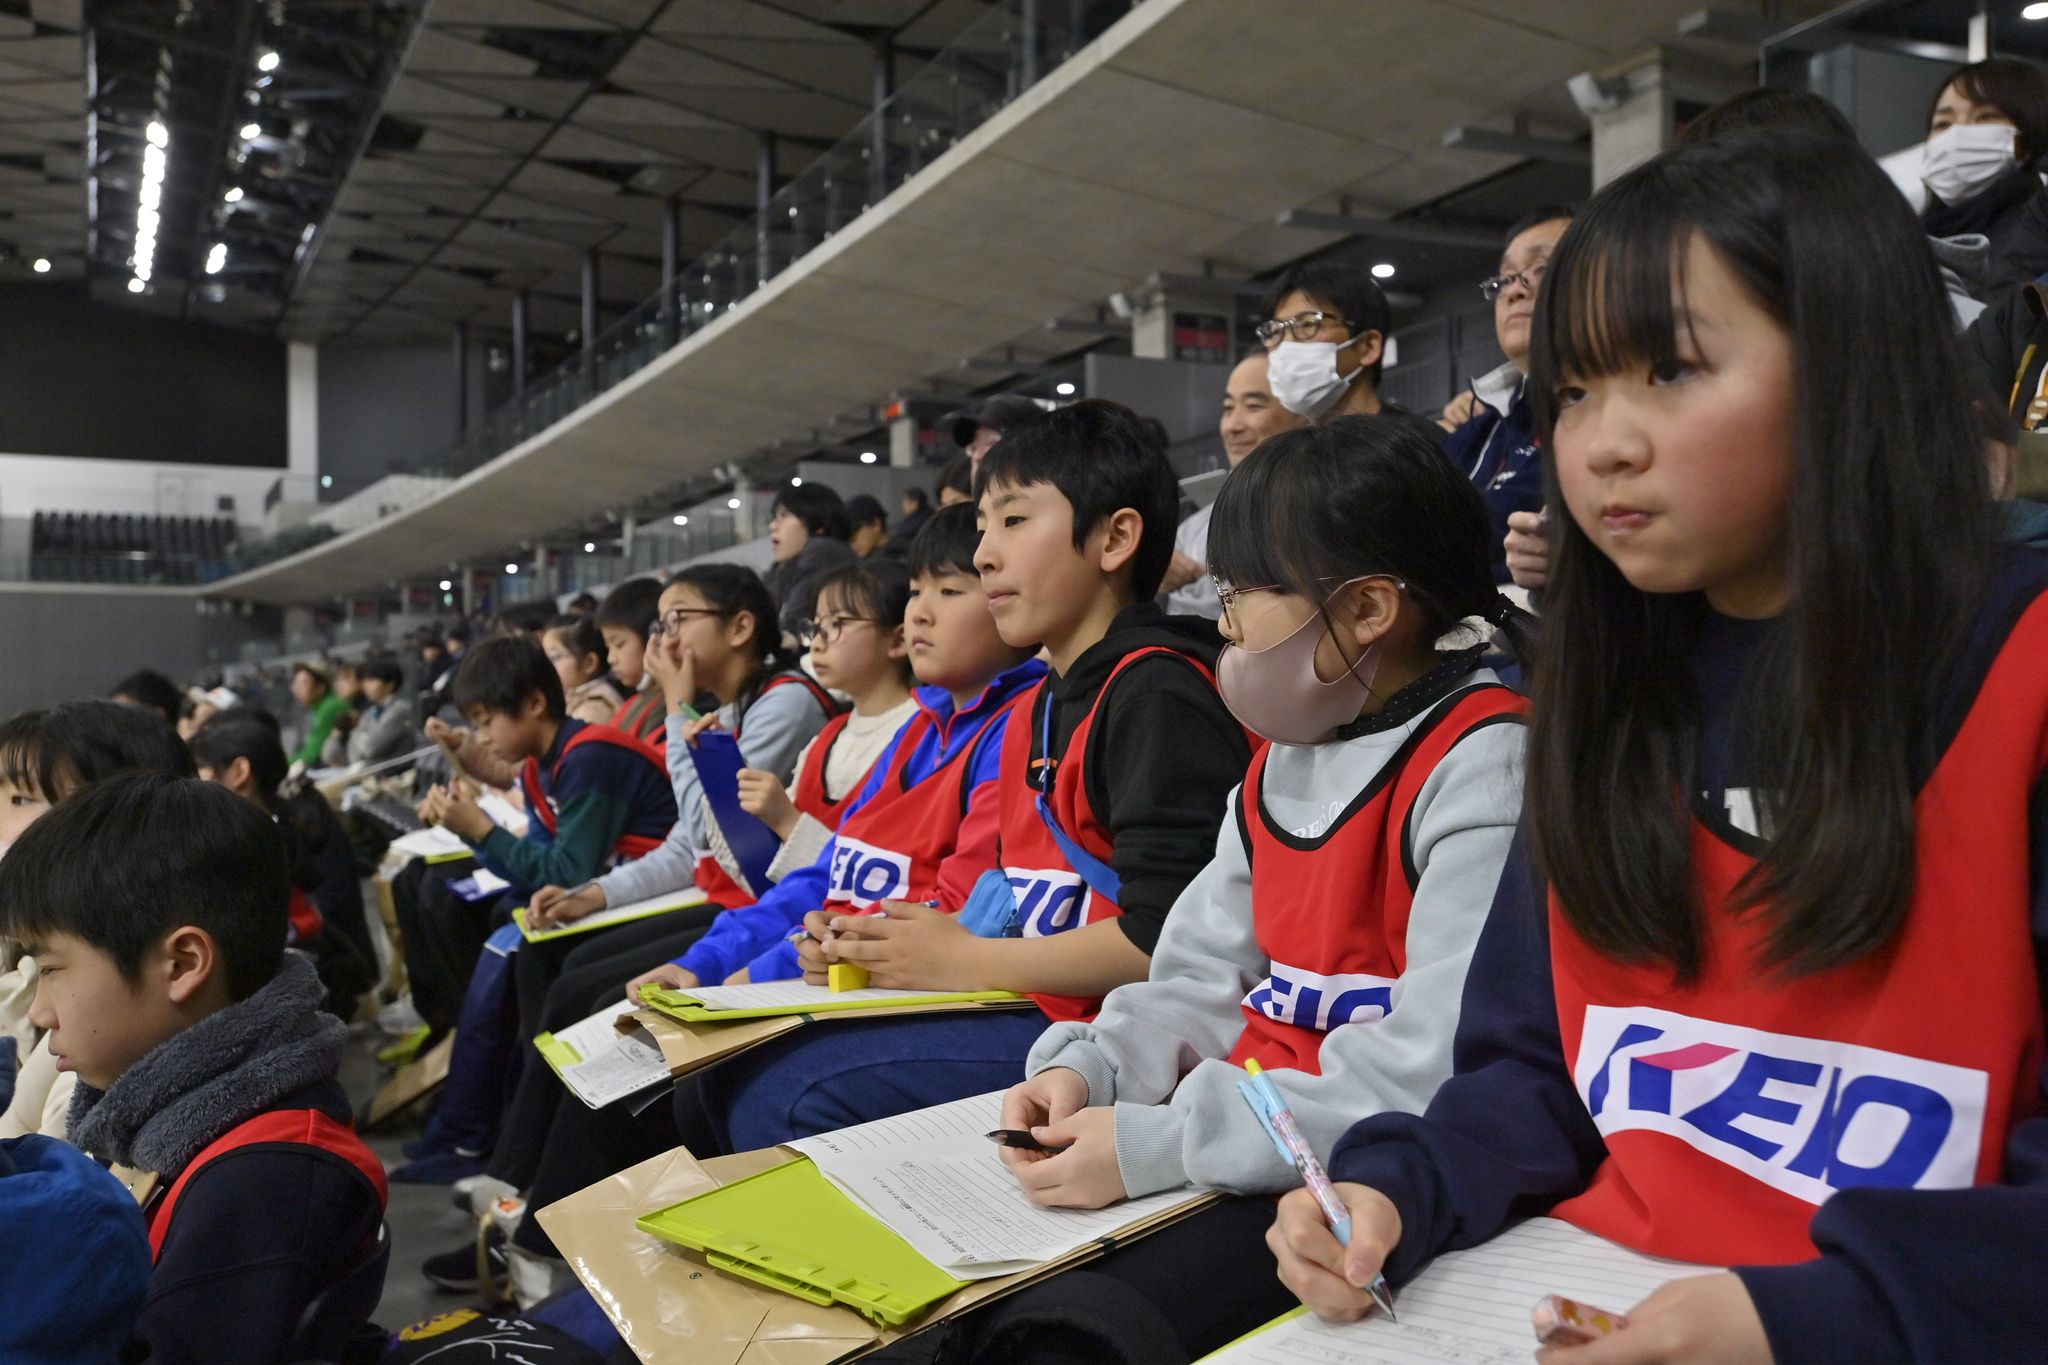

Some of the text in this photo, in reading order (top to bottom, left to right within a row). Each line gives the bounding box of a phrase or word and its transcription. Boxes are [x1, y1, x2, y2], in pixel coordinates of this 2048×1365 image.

[829, 844, 901, 901] EIO
[1249, 974, 1393, 1031] EIO
[1588, 1023, 1953, 1192] KEIO
